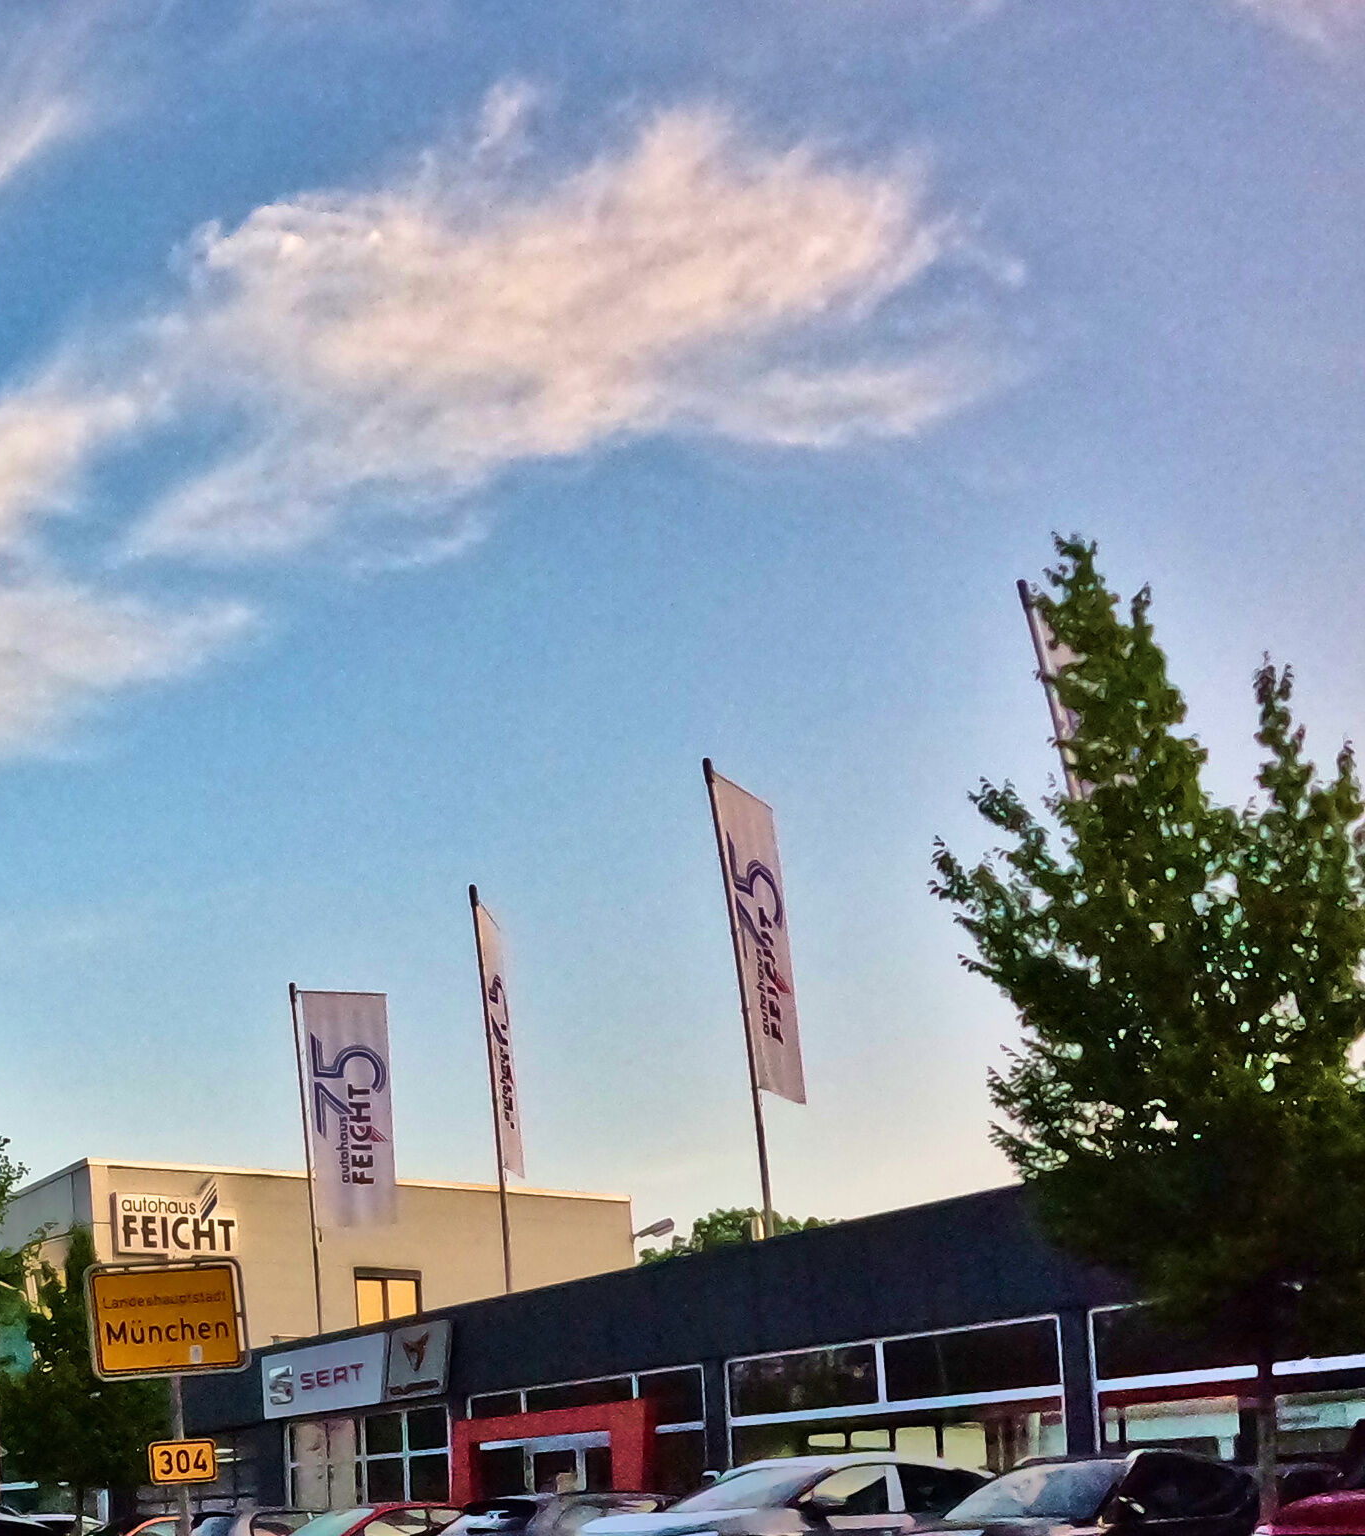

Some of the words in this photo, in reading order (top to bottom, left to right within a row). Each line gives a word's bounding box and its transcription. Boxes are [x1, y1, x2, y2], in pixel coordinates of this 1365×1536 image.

[347, 1084, 375, 1184] FEICHT
[335, 1116, 349, 1183] autohaus
[121, 1197, 196, 1215] autohaus
[122, 1214, 235, 1251] FEICHT
[106, 1318, 229, 1345] München
[300, 1363, 364, 1390] SEAT
[159, 1449, 207, 1475] 304
